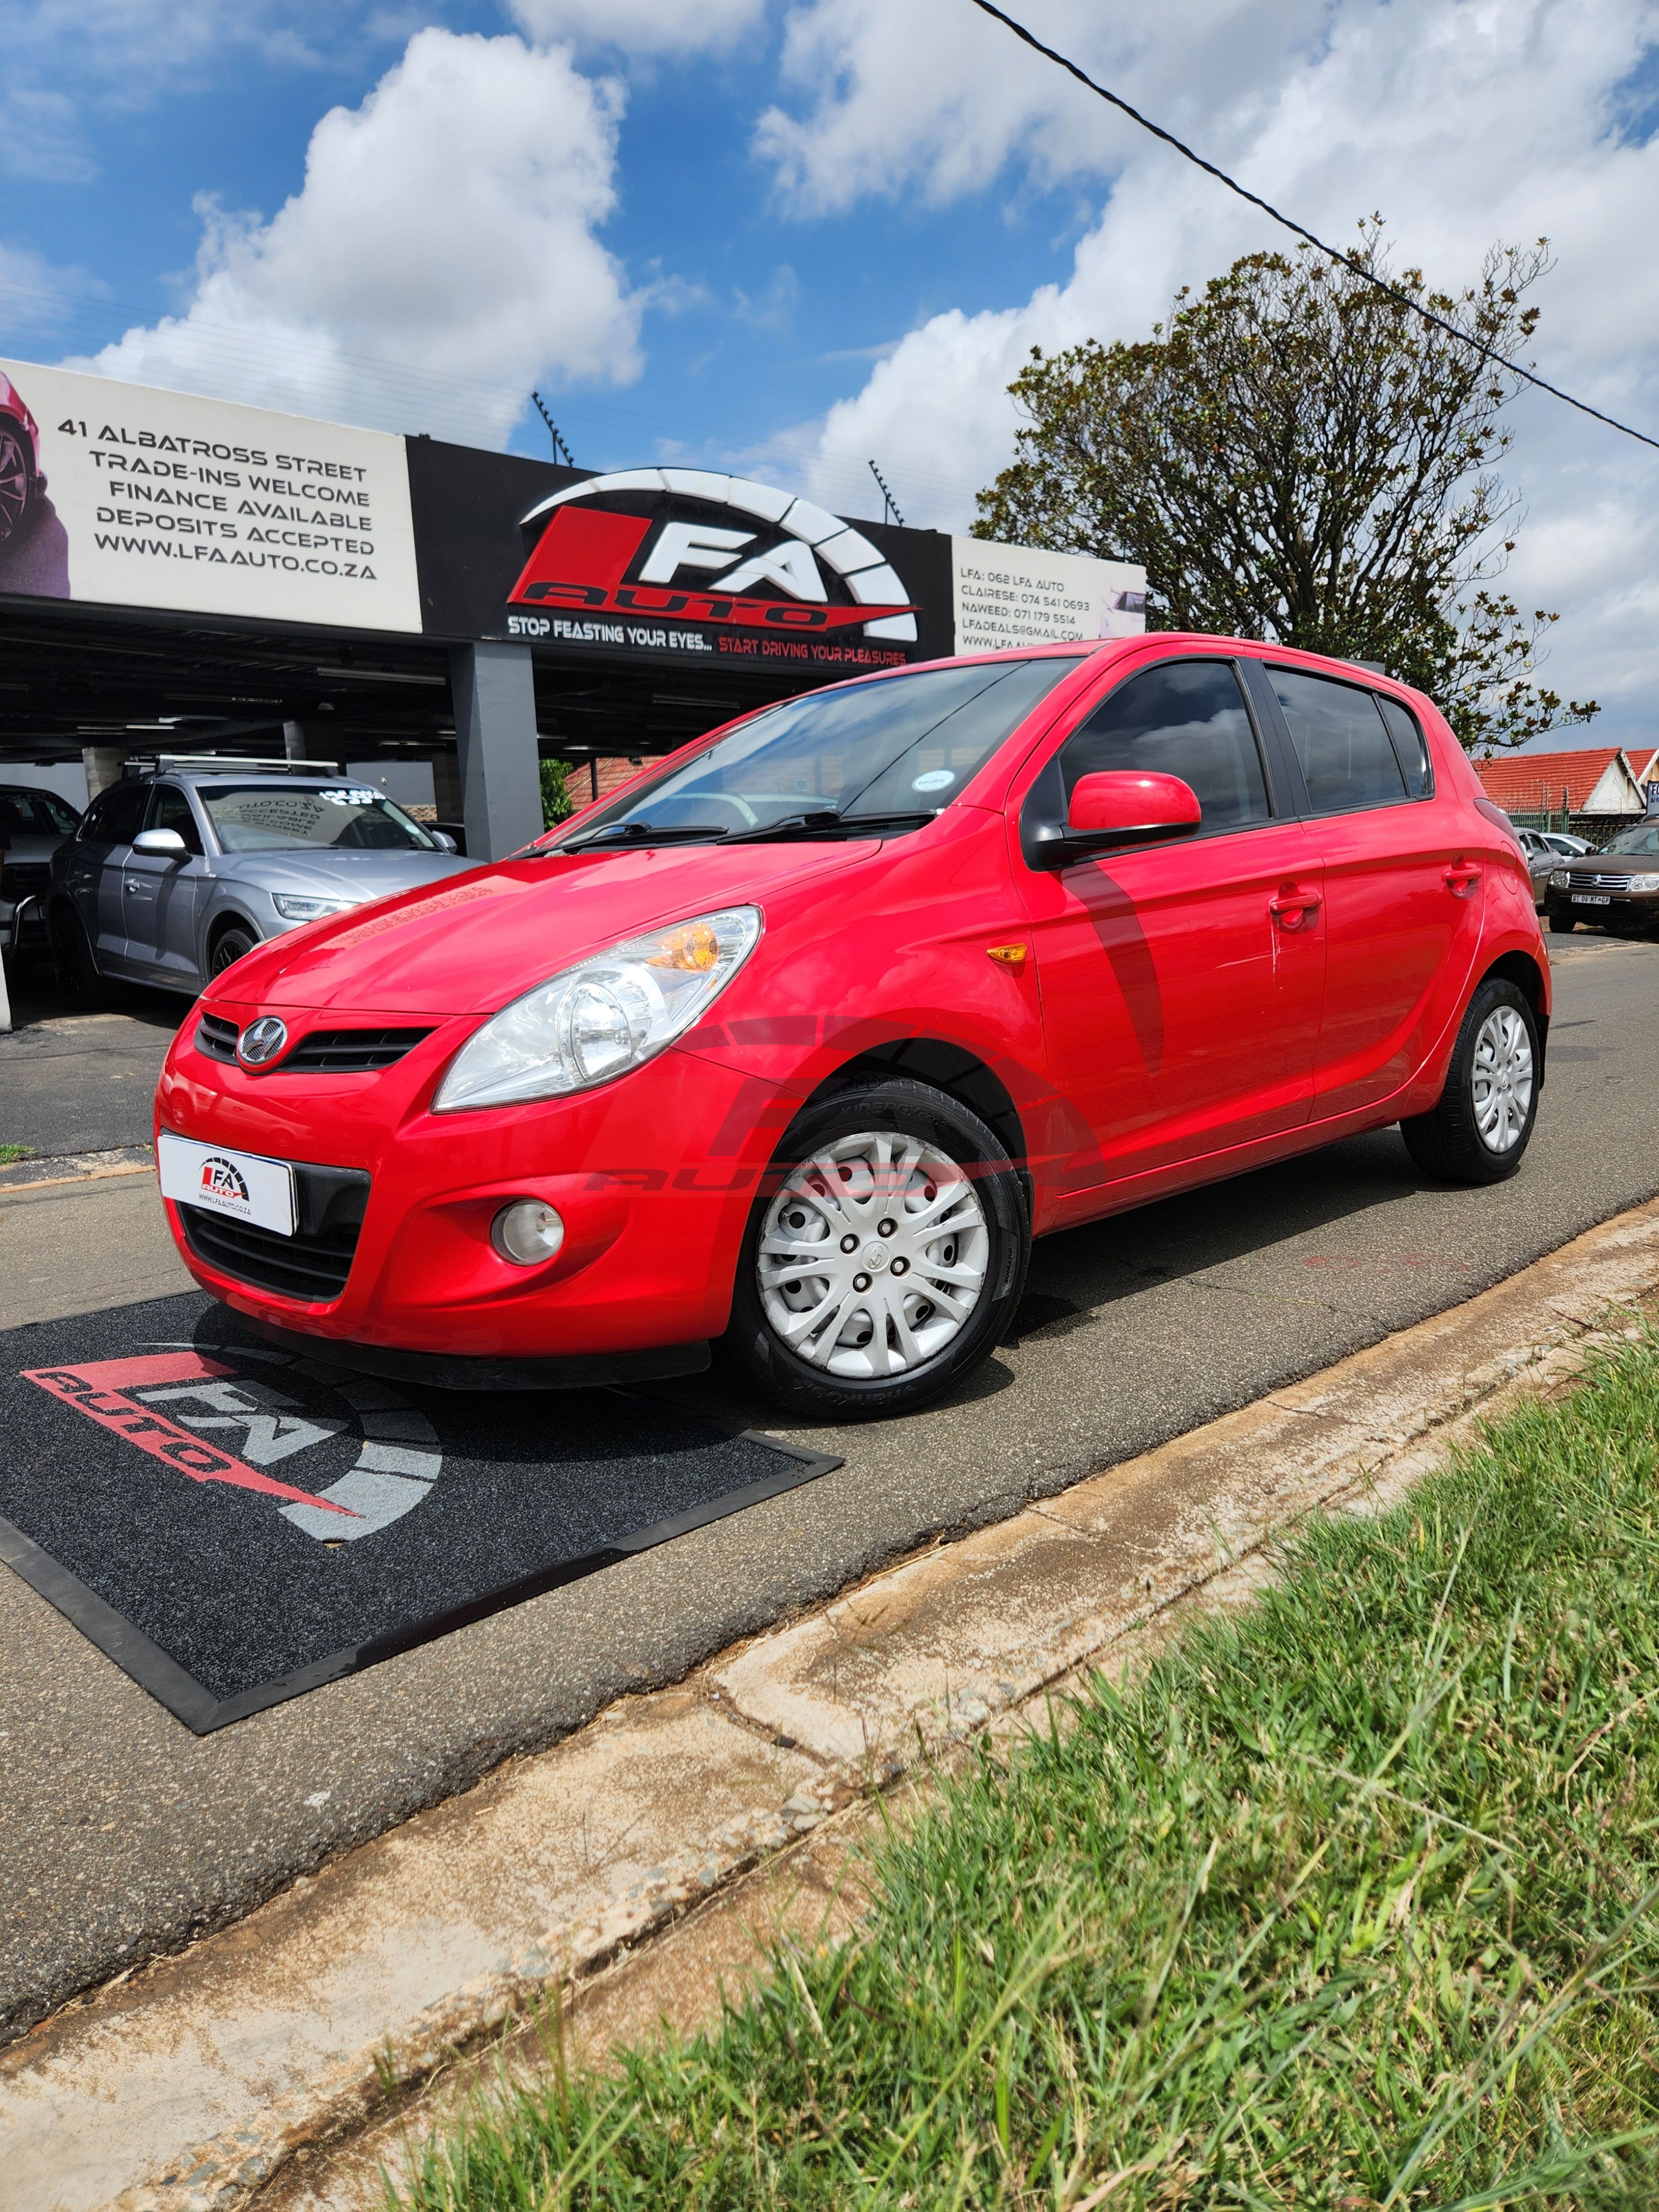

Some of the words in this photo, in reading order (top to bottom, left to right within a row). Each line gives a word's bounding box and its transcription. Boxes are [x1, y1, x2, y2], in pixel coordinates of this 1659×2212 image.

[58, 419, 87, 438] 41
[97, 425, 268, 465] ALBATROSS
[275, 454, 367, 482] STREET
[89, 450, 241, 487] TRADE-INS
[248, 475, 370, 507] WELCOME
[109, 481, 228, 512] FINANCE
[237, 500, 373, 531] AVAILABLE
[96, 507, 238, 539] DEPOSITS
[246, 527, 375, 555] ACCEPTED
[94, 533, 377, 580] WWW.LFAAUTO.CO.ZA
[961, 568, 985, 581] LFA:
[988, 572, 1010, 584] 062
[1013, 576, 1032, 588] LFA
[1035, 580, 1064, 592] AUTO
[961, 585, 1018, 602] CLAIRESE:
[1021, 594, 1040, 605] 074
[1043, 597, 1060, 608] 541
[1063, 600, 1090, 611] 0693
[523, 581, 829, 627] AUTO
[962, 602, 1011, 617] NAWEED:
[1014, 609, 1031, 620] 071
[1034, 612, 1050, 622] 179
[1054, 614, 1076, 625] 5514
[508, 616, 550, 635] STOP
[554, 619, 625, 643] FEASTING
[627, 626, 667, 647] YOUR
[669, 631, 712, 651] EYES...
[962, 618, 1083, 641] LFADEALS@GMAIL.COM
[719, 637, 759, 654] START
[762, 642, 808, 659] DRIVING
[810, 644, 842, 662] YOUR
[199, 1193, 251, 1215] WWW.LFAAUTO.CO.ZA
[202, 1184, 234, 1197] AUTO
[1004, 1247, 1013, 1285] OUTSIDE
[35, 1371, 232, 1473] AUTO
